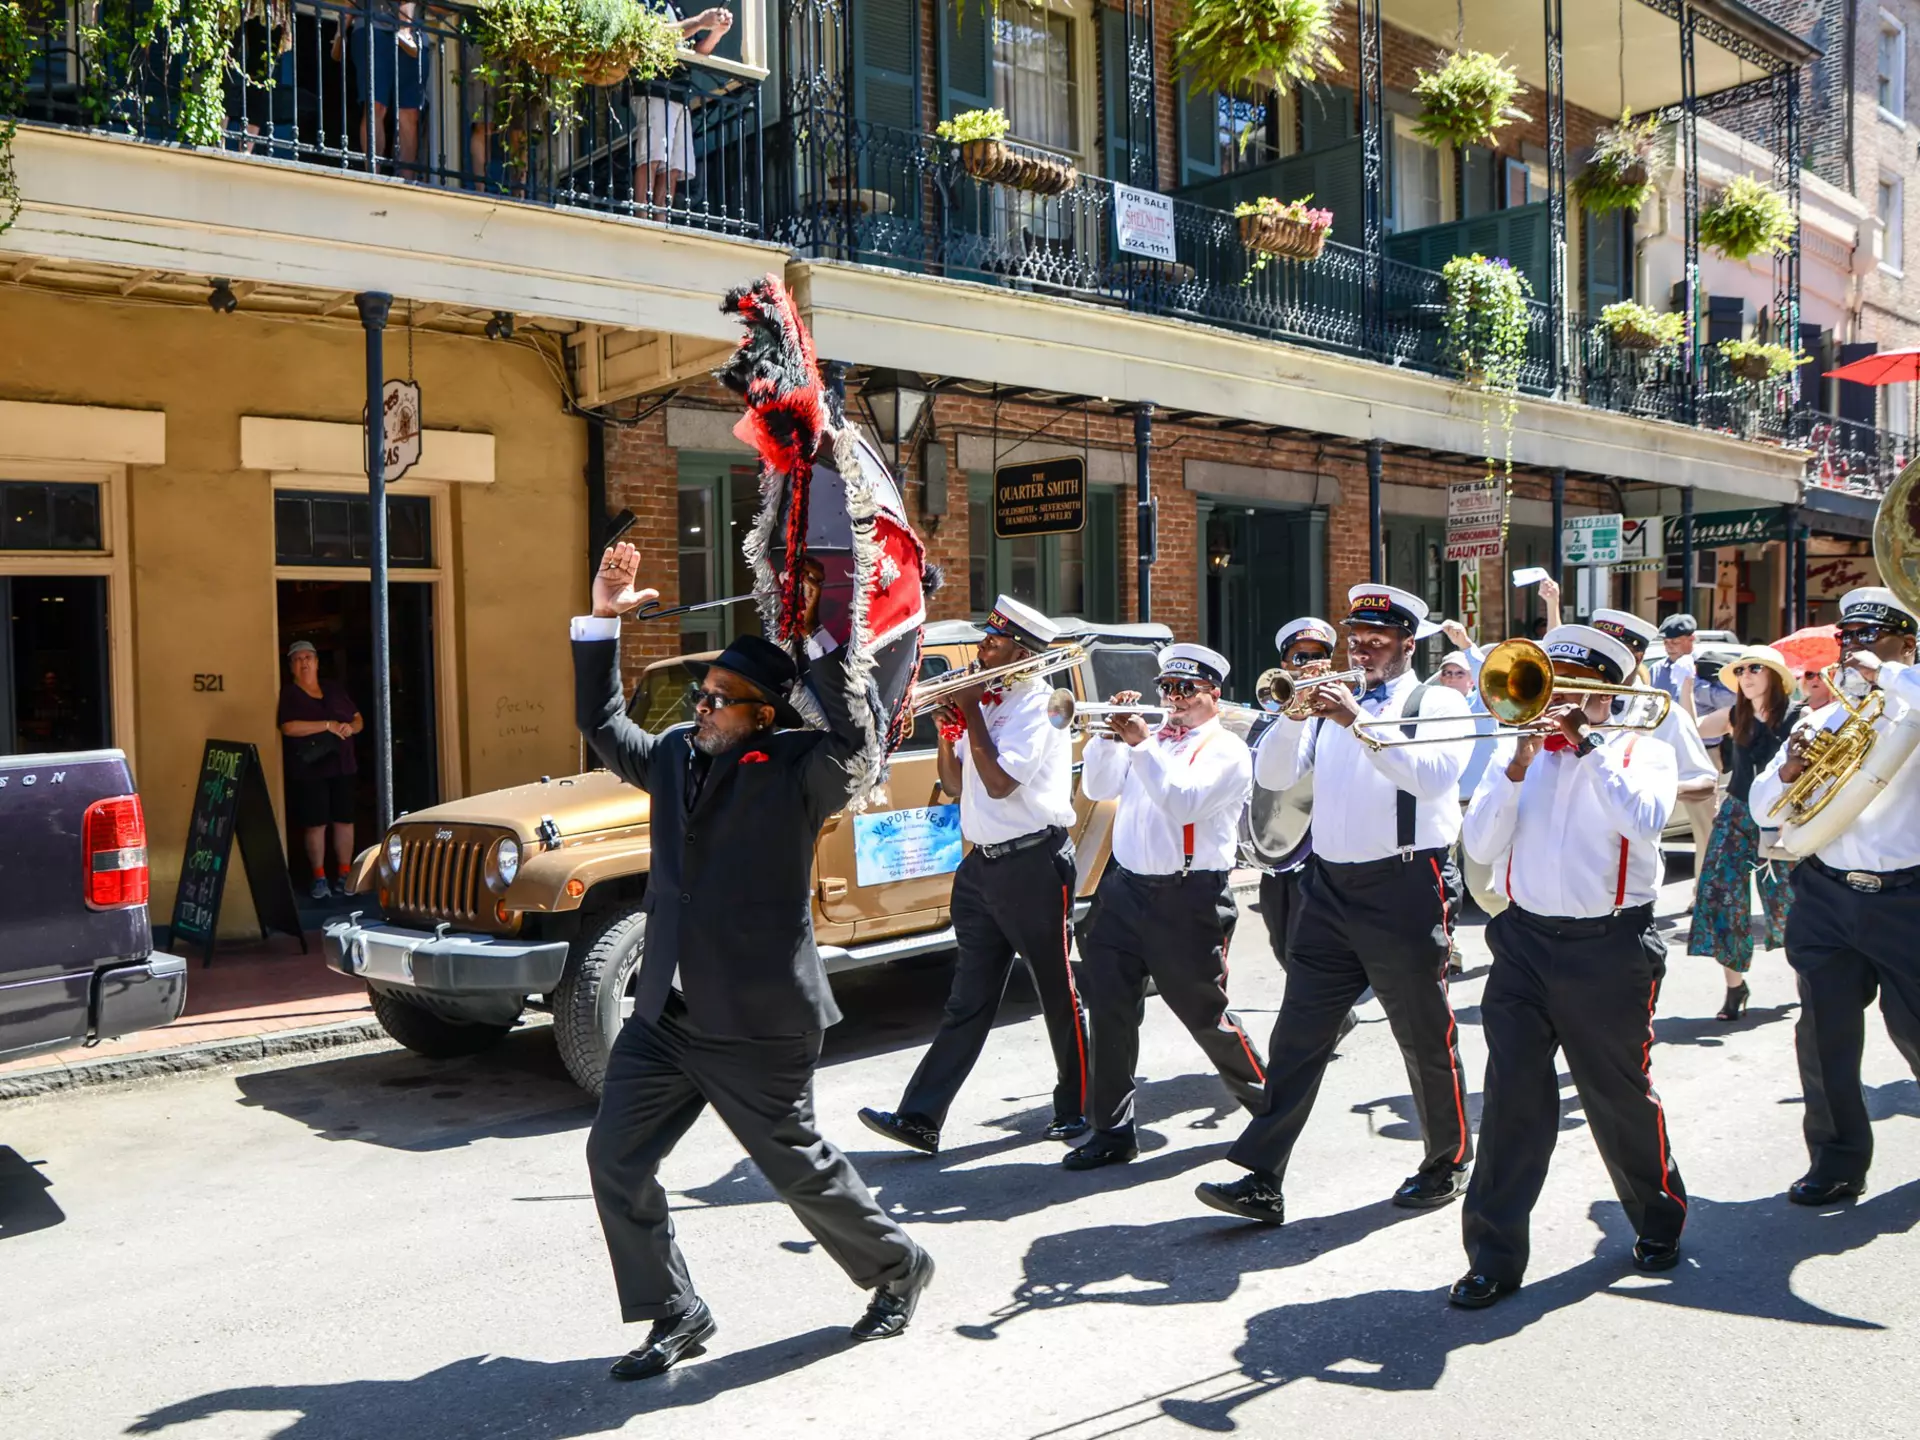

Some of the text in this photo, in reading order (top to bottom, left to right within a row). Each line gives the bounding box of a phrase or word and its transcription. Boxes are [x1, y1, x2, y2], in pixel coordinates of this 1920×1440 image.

[1120, 191, 1169, 211] FOR SALE
[1125, 237, 1170, 255] 524-1111
[1032, 472, 1046, 482] THE
[1000, 479, 1079, 504] QUARTER SMITH
[1452, 485, 1471, 494] FOR
[998, 505, 1034, 517] GOLDSMITH
[1005, 510, 1073, 526] DIAMONDS JEWELRY
[1563, 519, 1580, 529] PAY
[1582, 518, 1593, 528] TO
[1573, 530, 1581, 543] 2
[1447, 543, 1500, 559] HAUNTED
[1565, 544, 1588, 552] HOUR
[1548, 644, 1587, 657] NFOLK
[193, 673, 225, 692] 521
[872, 810, 912, 836] VAPOR
[916, 809, 947, 828] EYES
[435, 827, 453, 842] Jeep
